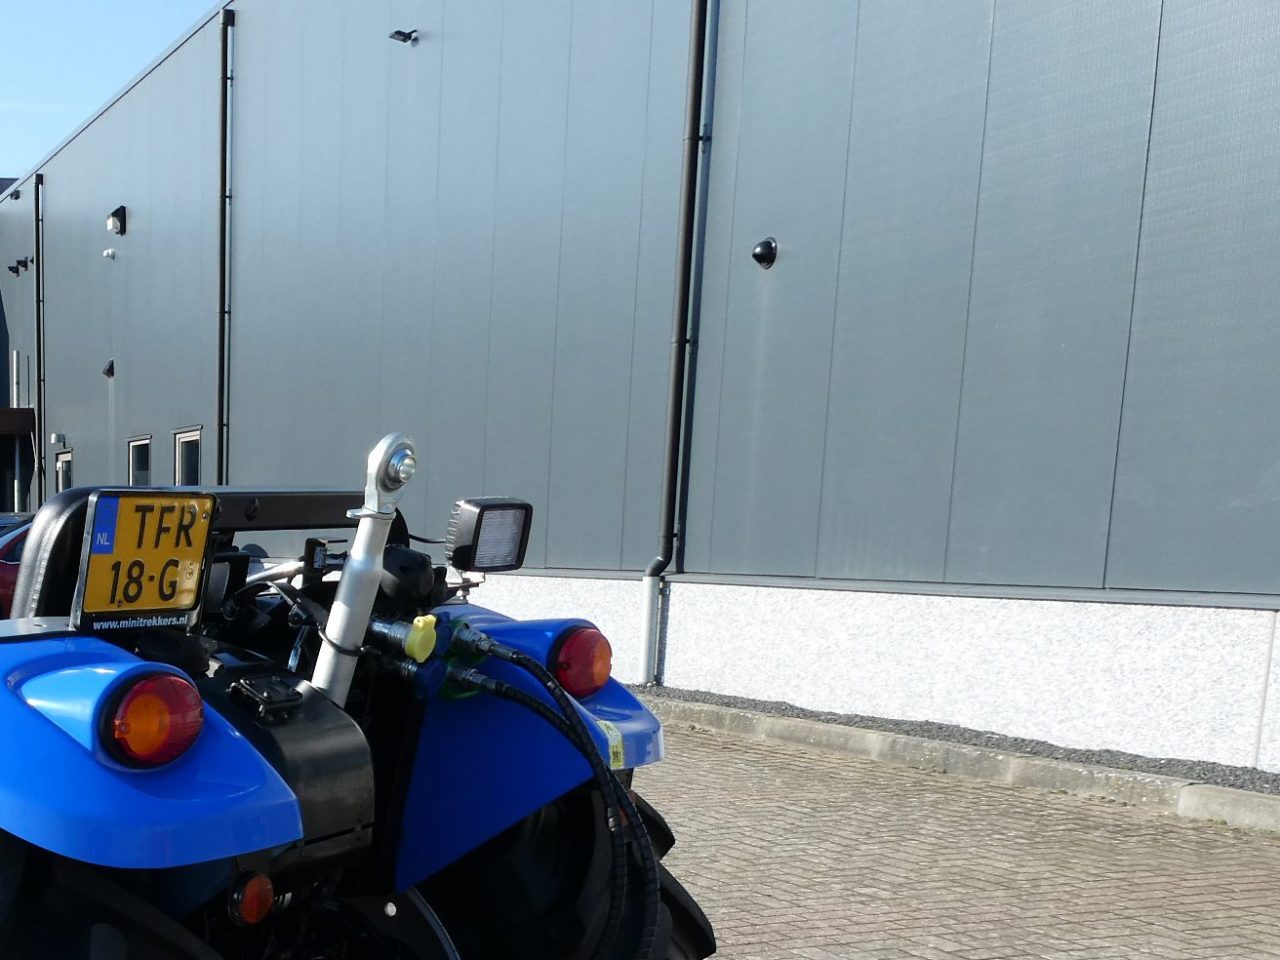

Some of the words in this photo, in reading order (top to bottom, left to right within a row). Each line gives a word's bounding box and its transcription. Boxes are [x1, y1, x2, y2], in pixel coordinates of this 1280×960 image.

[135, 504, 197, 549] TFR
[96, 533, 110, 545] NL
[93, 615, 188, 631] www.minitrekkers.nl
